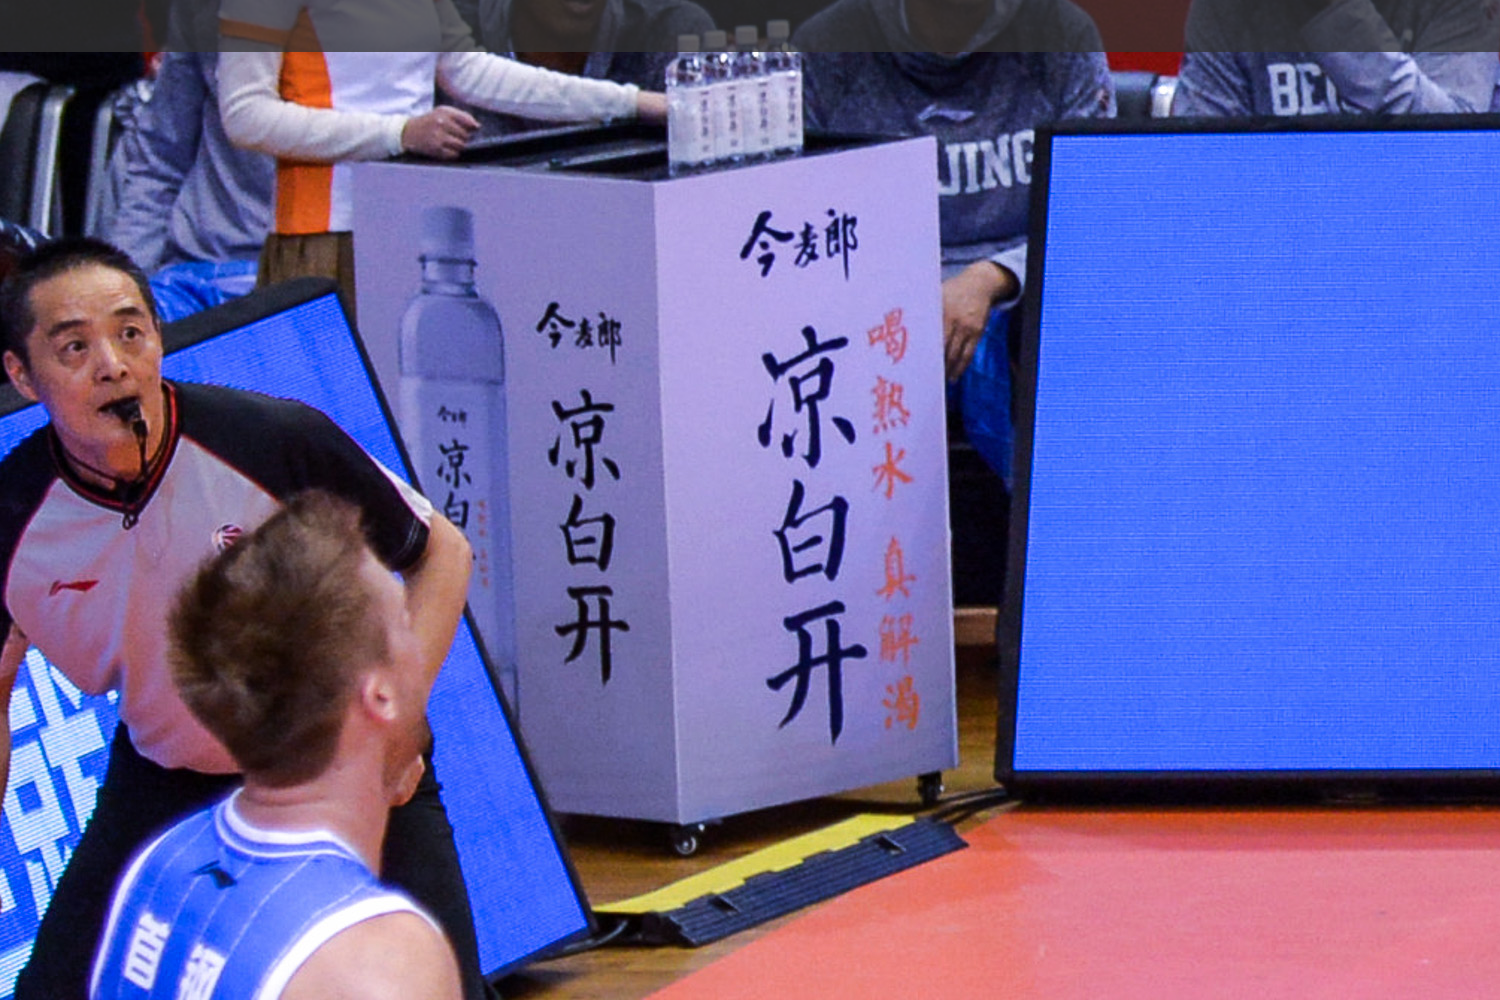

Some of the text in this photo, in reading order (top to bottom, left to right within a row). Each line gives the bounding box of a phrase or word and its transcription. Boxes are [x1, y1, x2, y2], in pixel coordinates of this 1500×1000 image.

[740, 208, 858, 282] 今麦郎
[536, 302, 622, 365] 今麦郎
[435, 438, 477, 560] 凉白
[547, 389, 631, 687] 凉白开
[757, 325, 868, 746] 凉白开
